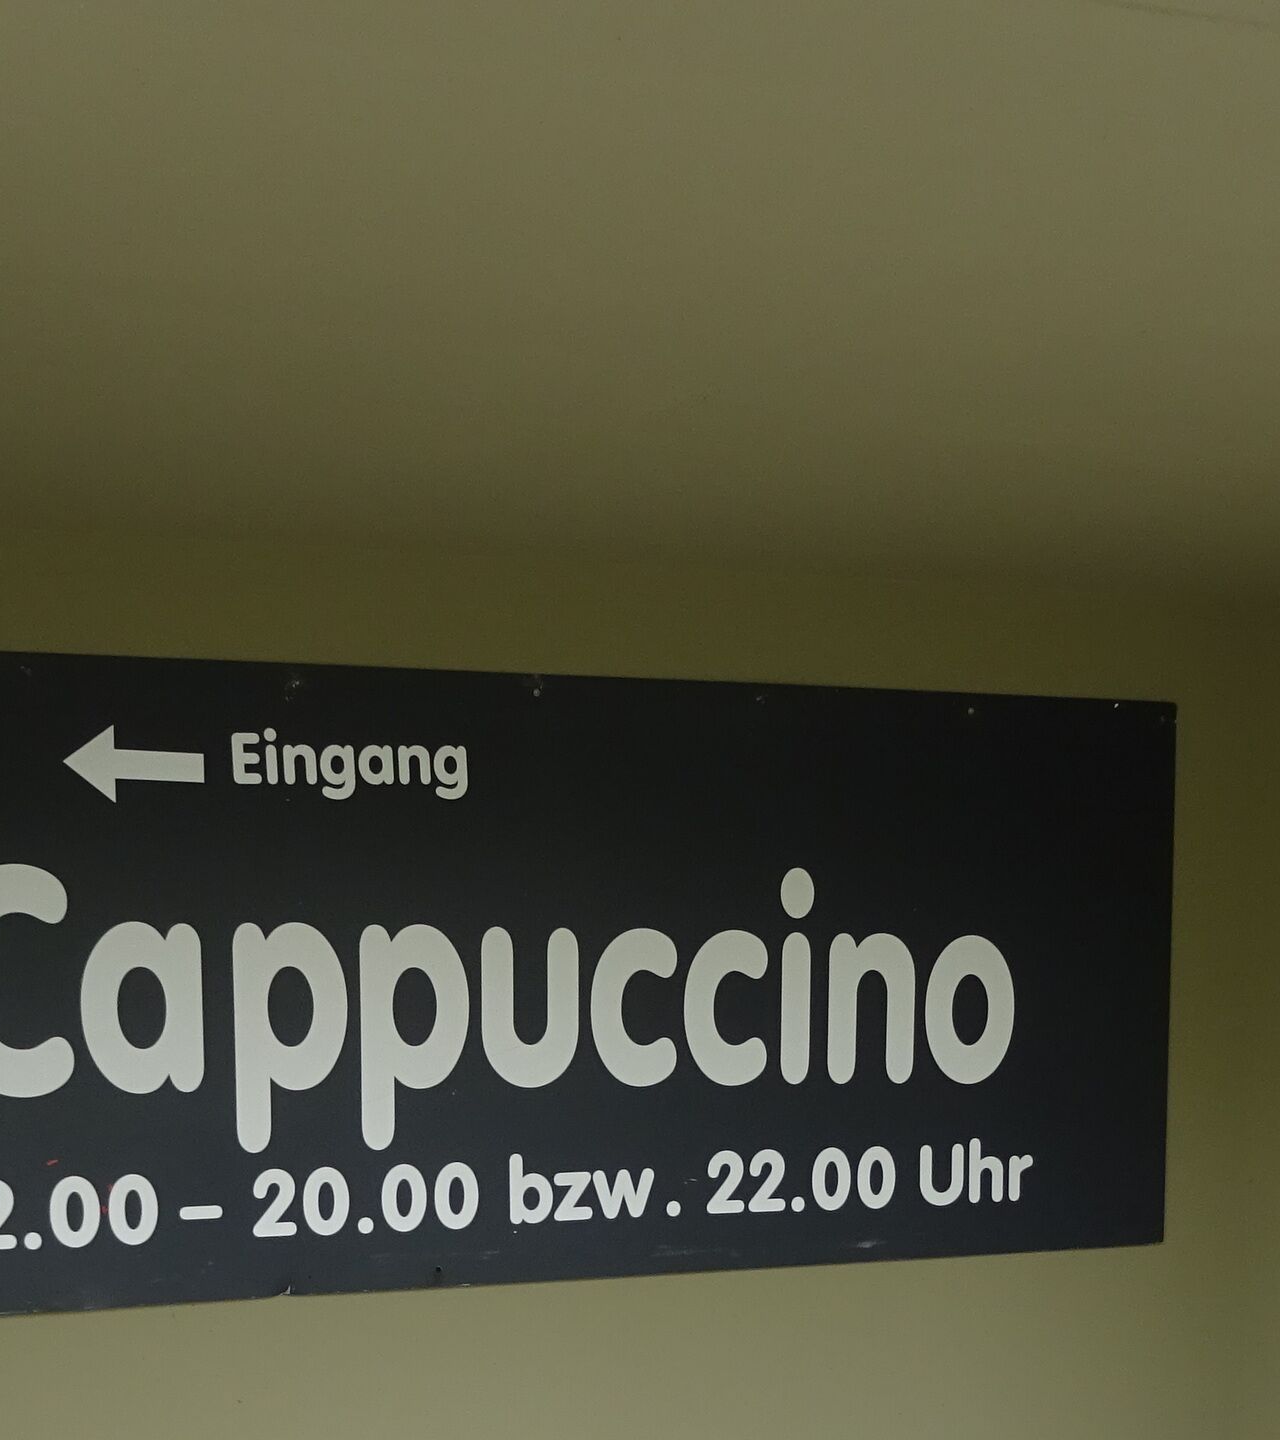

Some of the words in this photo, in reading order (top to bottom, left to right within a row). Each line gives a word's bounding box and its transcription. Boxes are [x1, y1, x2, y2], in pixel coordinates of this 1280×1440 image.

[231, 726, 469, 800] Eingang
[252, 1161, 480, 1238] 20.00
[508, 1153, 682, 1225] bzw.
[706, 1145, 897, 1215] 22.00
[919, 1137, 1034, 1207] Uhr
